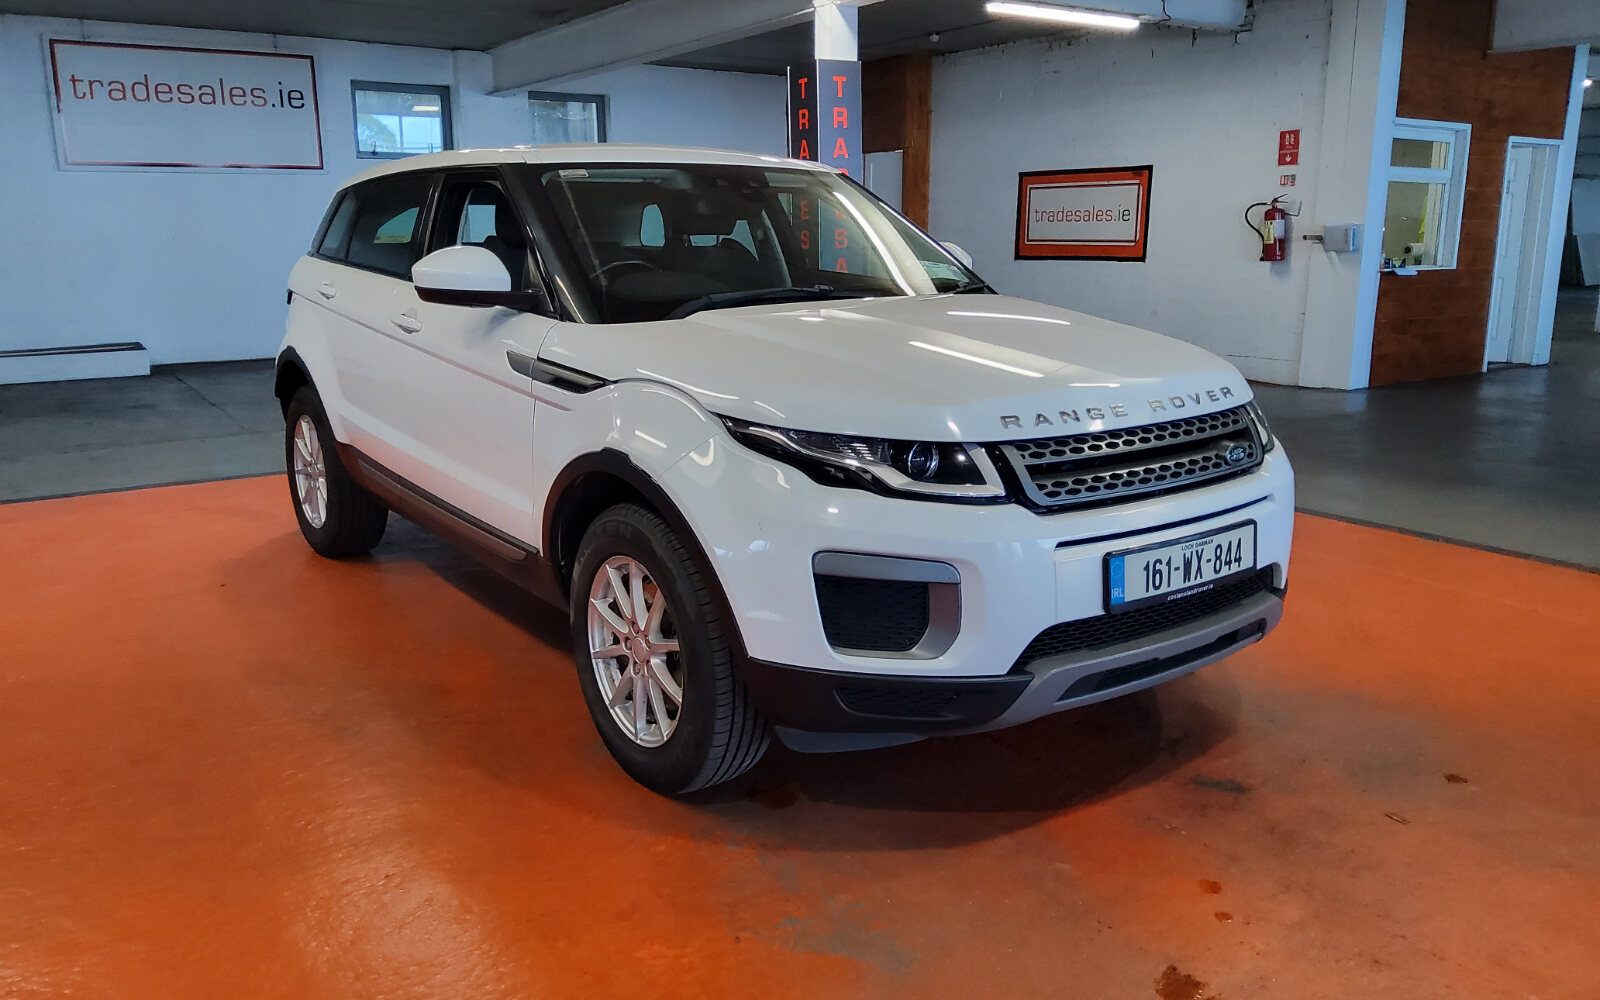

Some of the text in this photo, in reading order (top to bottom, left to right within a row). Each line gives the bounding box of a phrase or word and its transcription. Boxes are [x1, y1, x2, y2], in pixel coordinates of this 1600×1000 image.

[69, 74, 305, 110] tradesales.ie
[1034, 204, 1131, 223] tradesales.ie
[1000, 386, 1235, 430] RANGE ROVER
[1181, 543, 1194, 551] LOCH
[1143, 537, 1243, 594] 161-WX-844
[1111, 587, 1125, 600] IRL
